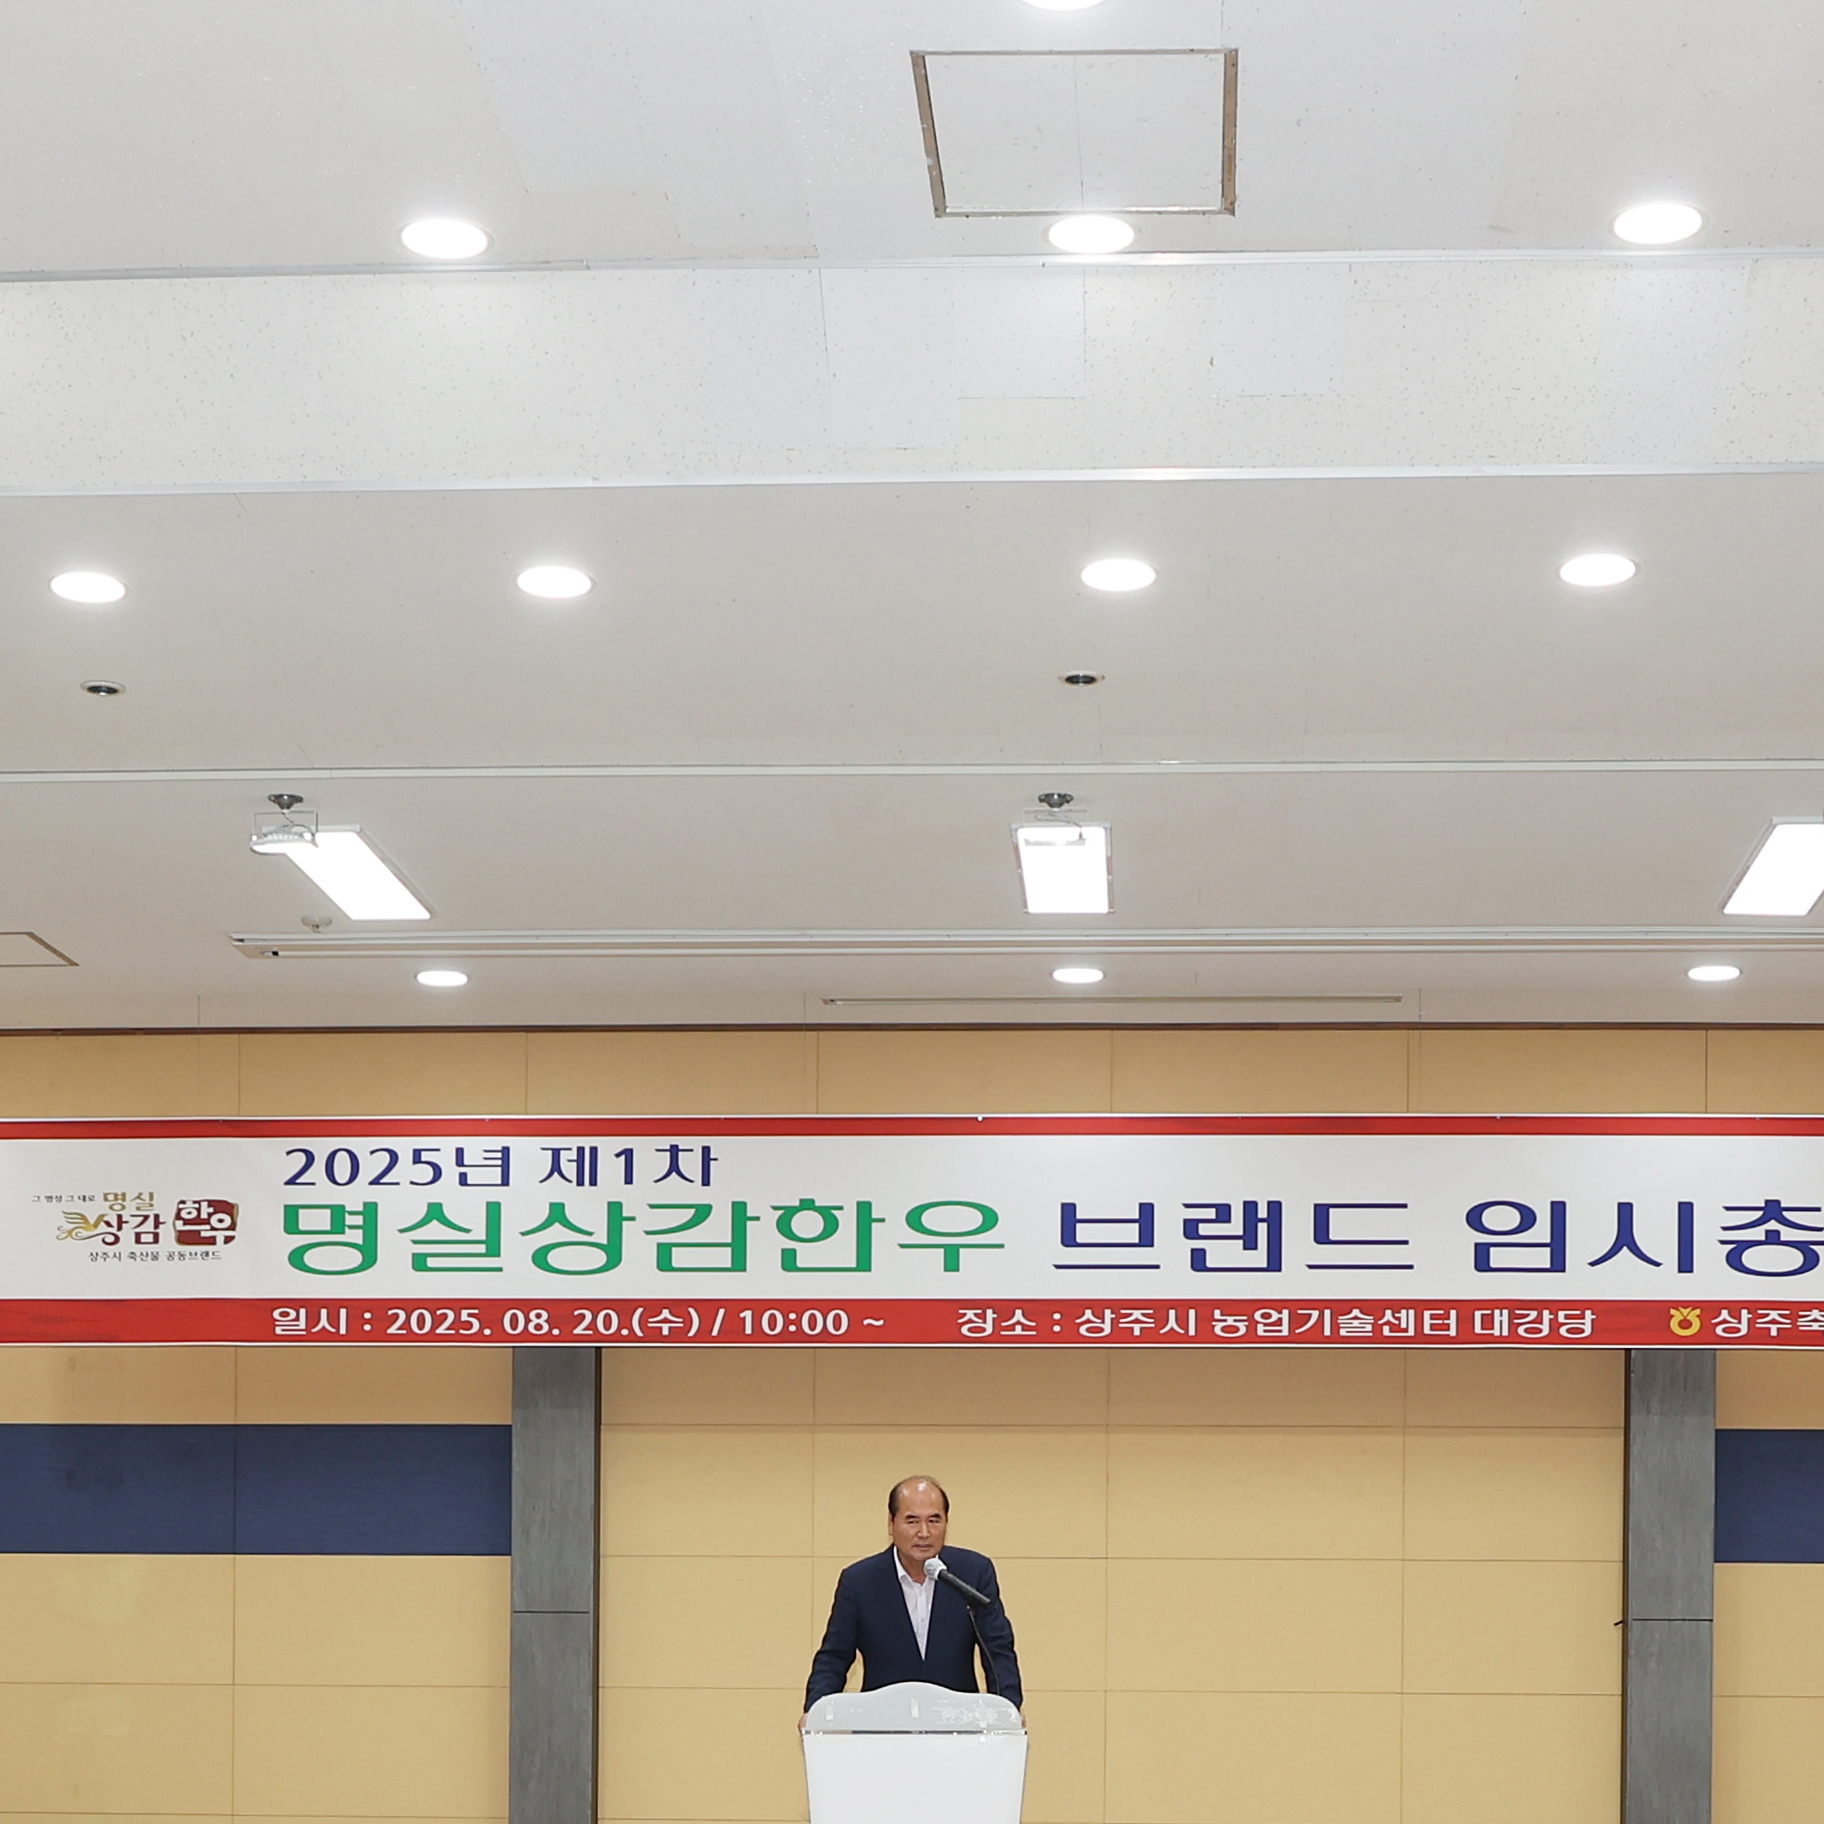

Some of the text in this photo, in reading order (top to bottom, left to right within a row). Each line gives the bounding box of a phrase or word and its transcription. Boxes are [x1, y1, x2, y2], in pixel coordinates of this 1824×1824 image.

[282, 1143, 719, 1188] 2025년 제1차
[102, 1191, 155, 1212] 명실
[100, 1212, 167, 1247] 상감
[175, 1200, 237, 1247] 한우
[281, 1197, 1006, 1277] 명실상감한우
[1052, 1199, 1415, 1274] 브랜드
[88, 1250, 223, 1262] 상주시 축산물 공동브랜드
[271, 1306, 349, 1336] 일시
[385, 1308, 491, 1336] 2025.
[502, 1308, 560, 1336] 08.
[572, 1307, 700, 1337] 20.(수)
[737, 1308, 849, 1336] 10:00
[956, 1307, 1038, 1338] 장소
[1073, 1307, 1197, 1338] 상주시
[1210, 1307, 1458, 1338] 농업기술센터
[1472, 1307, 1597, 1339] 대강당
